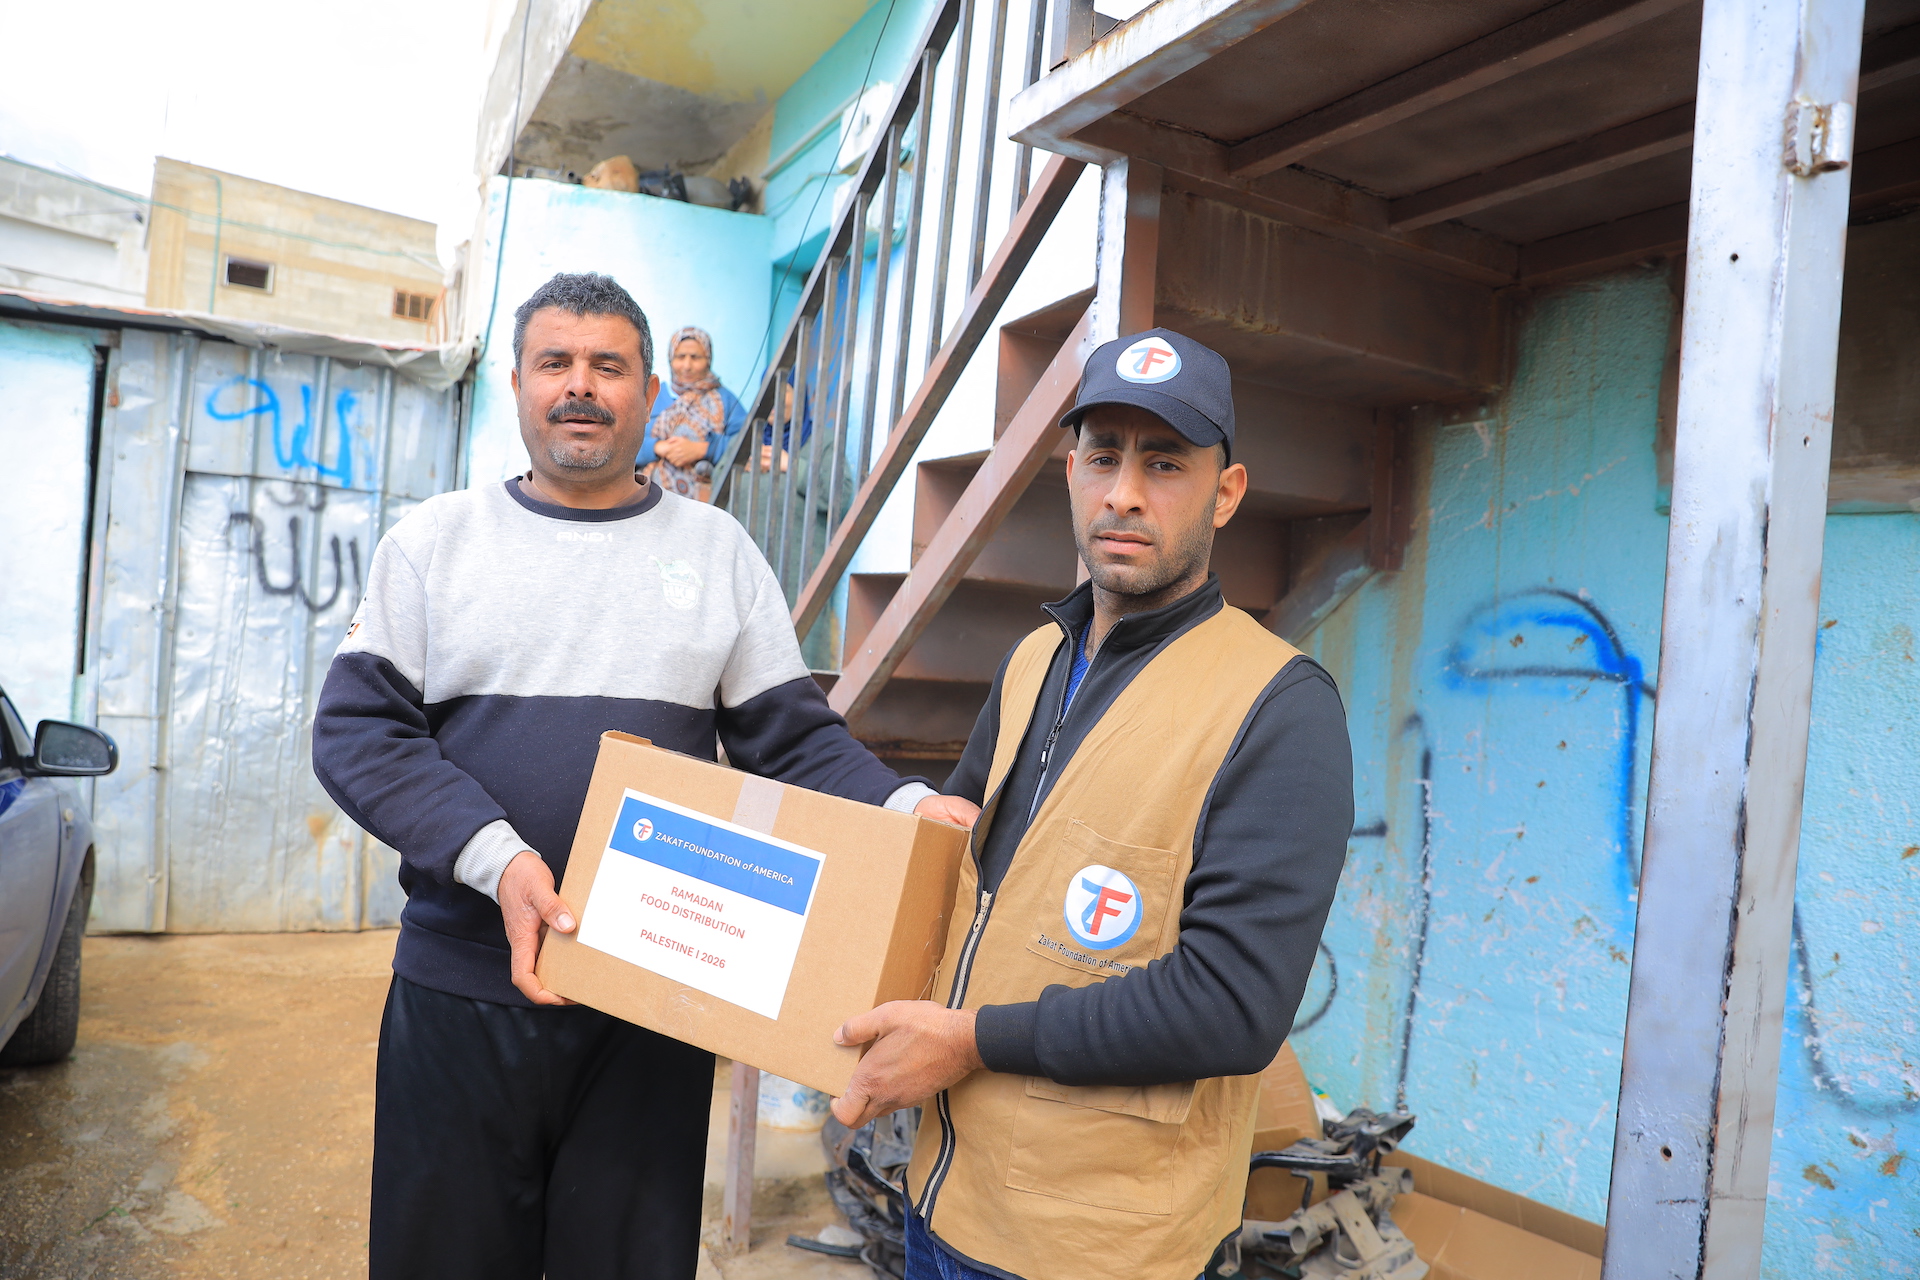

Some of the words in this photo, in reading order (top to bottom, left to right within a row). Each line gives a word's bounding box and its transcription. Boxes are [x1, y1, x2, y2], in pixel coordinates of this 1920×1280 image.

[655, 831, 683, 847] ZAKAT
[683, 841, 742, 868] FOUNDATION
[742, 863, 754, 872] of
[752, 865, 794, 885] AMERICA
[640, 893, 670, 911] FOOD
[672, 904, 746, 939] DISTRIBUTION
[671, 886, 724, 913] RAMADAN
[640, 929, 695, 957] PALESTINE
[700, 952, 726, 968] 2026
[1038, 934, 1058, 951] Zakat
[1058, 943, 1097, 967] Foundation
[1099, 959, 1108, 968] of
